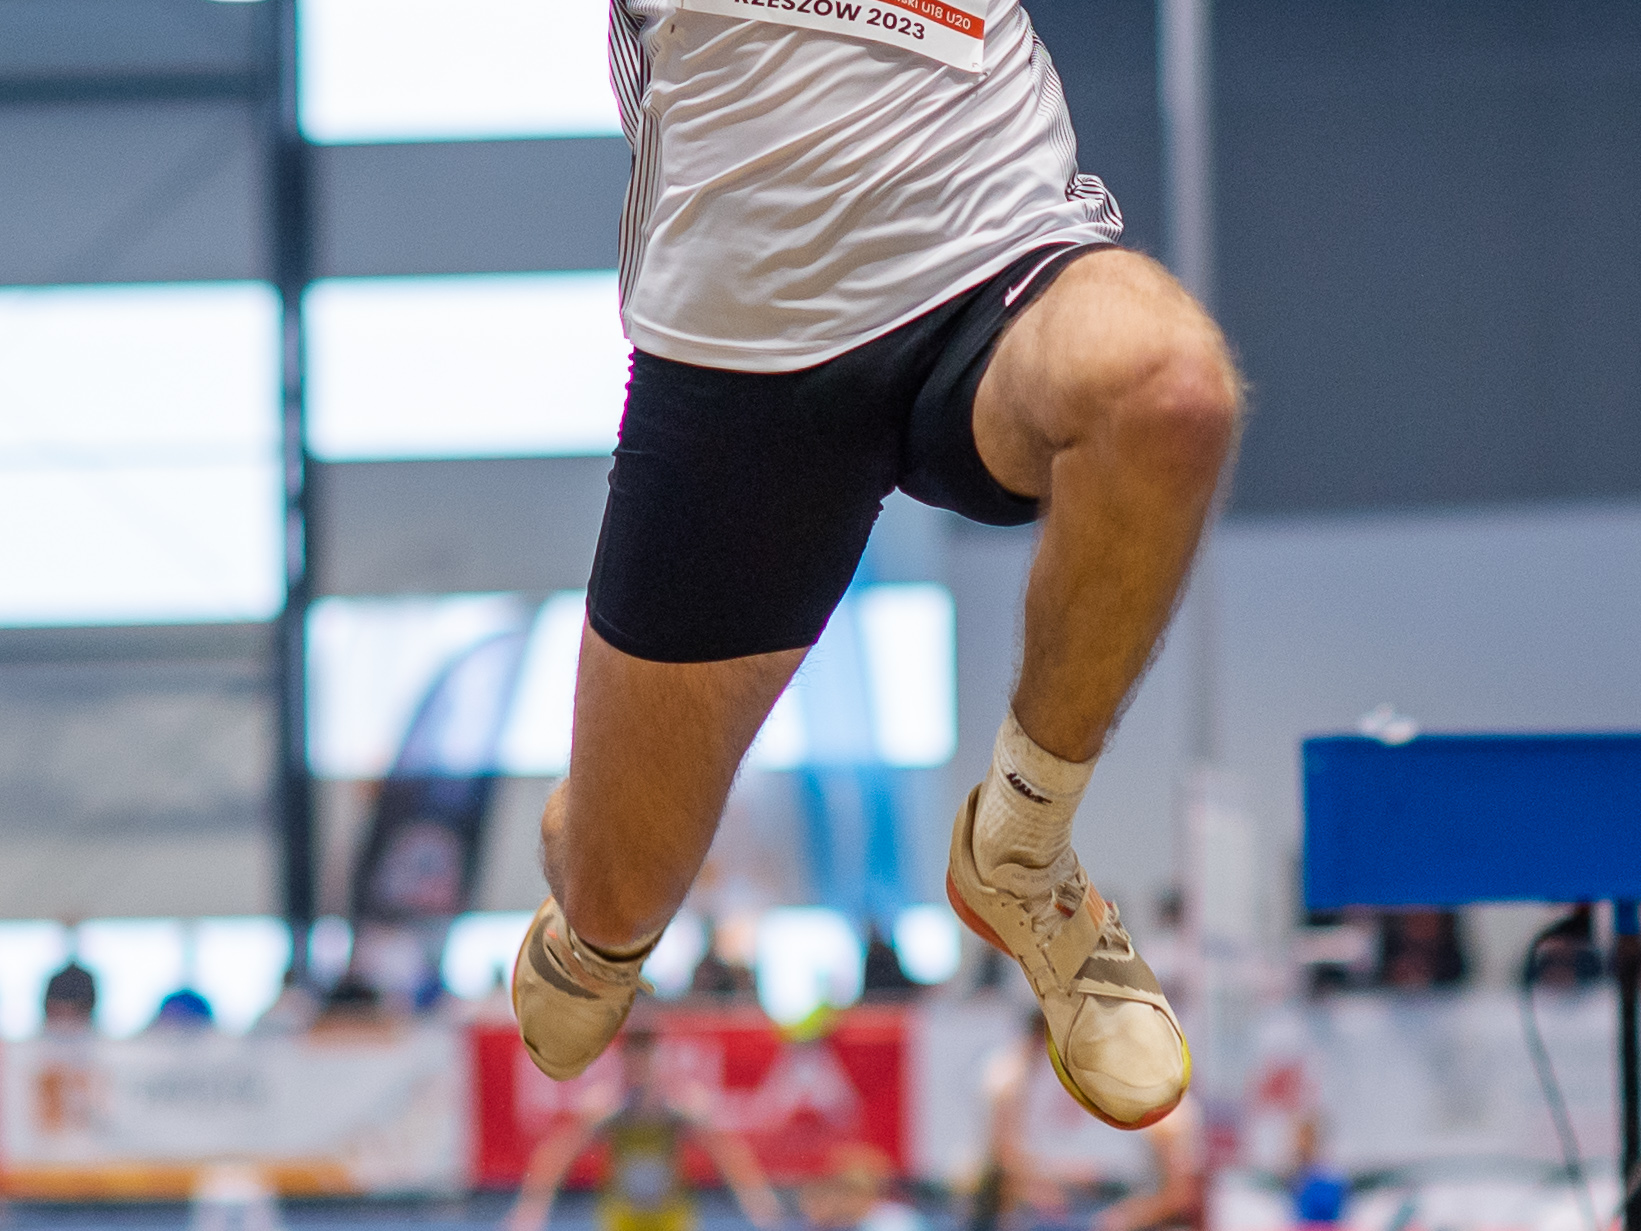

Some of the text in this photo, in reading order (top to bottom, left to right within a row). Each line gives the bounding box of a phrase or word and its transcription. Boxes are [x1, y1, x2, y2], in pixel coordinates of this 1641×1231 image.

[866, 7, 926, 40] 2023
[921, 0, 944, 20] U18
[946, 10, 972, 31] U20
